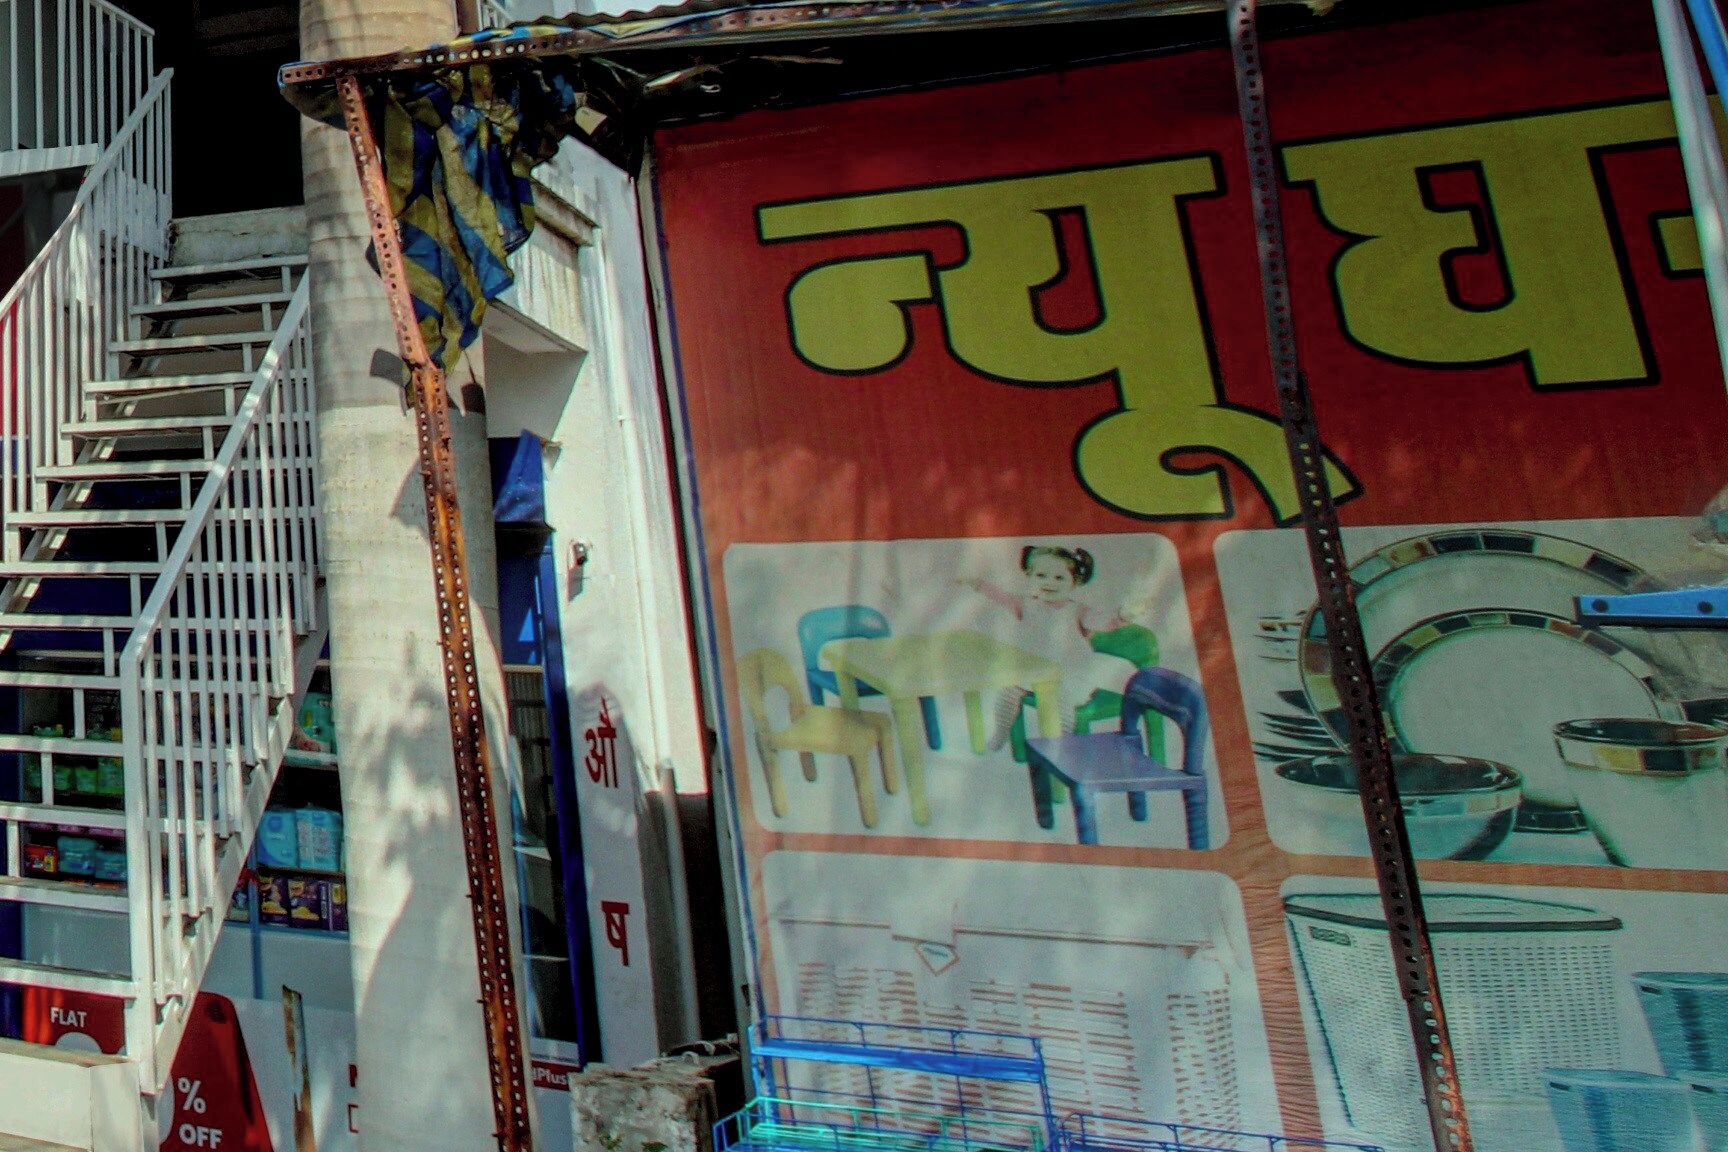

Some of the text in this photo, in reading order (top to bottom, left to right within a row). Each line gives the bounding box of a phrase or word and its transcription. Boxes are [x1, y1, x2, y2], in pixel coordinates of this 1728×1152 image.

[754, 91, 1728, 529] न्यू घ
[50, 1006, 87, 1028] FLAT
[178, 1076, 207, 1114] %
[179, 1123, 222, 1149] OFF
